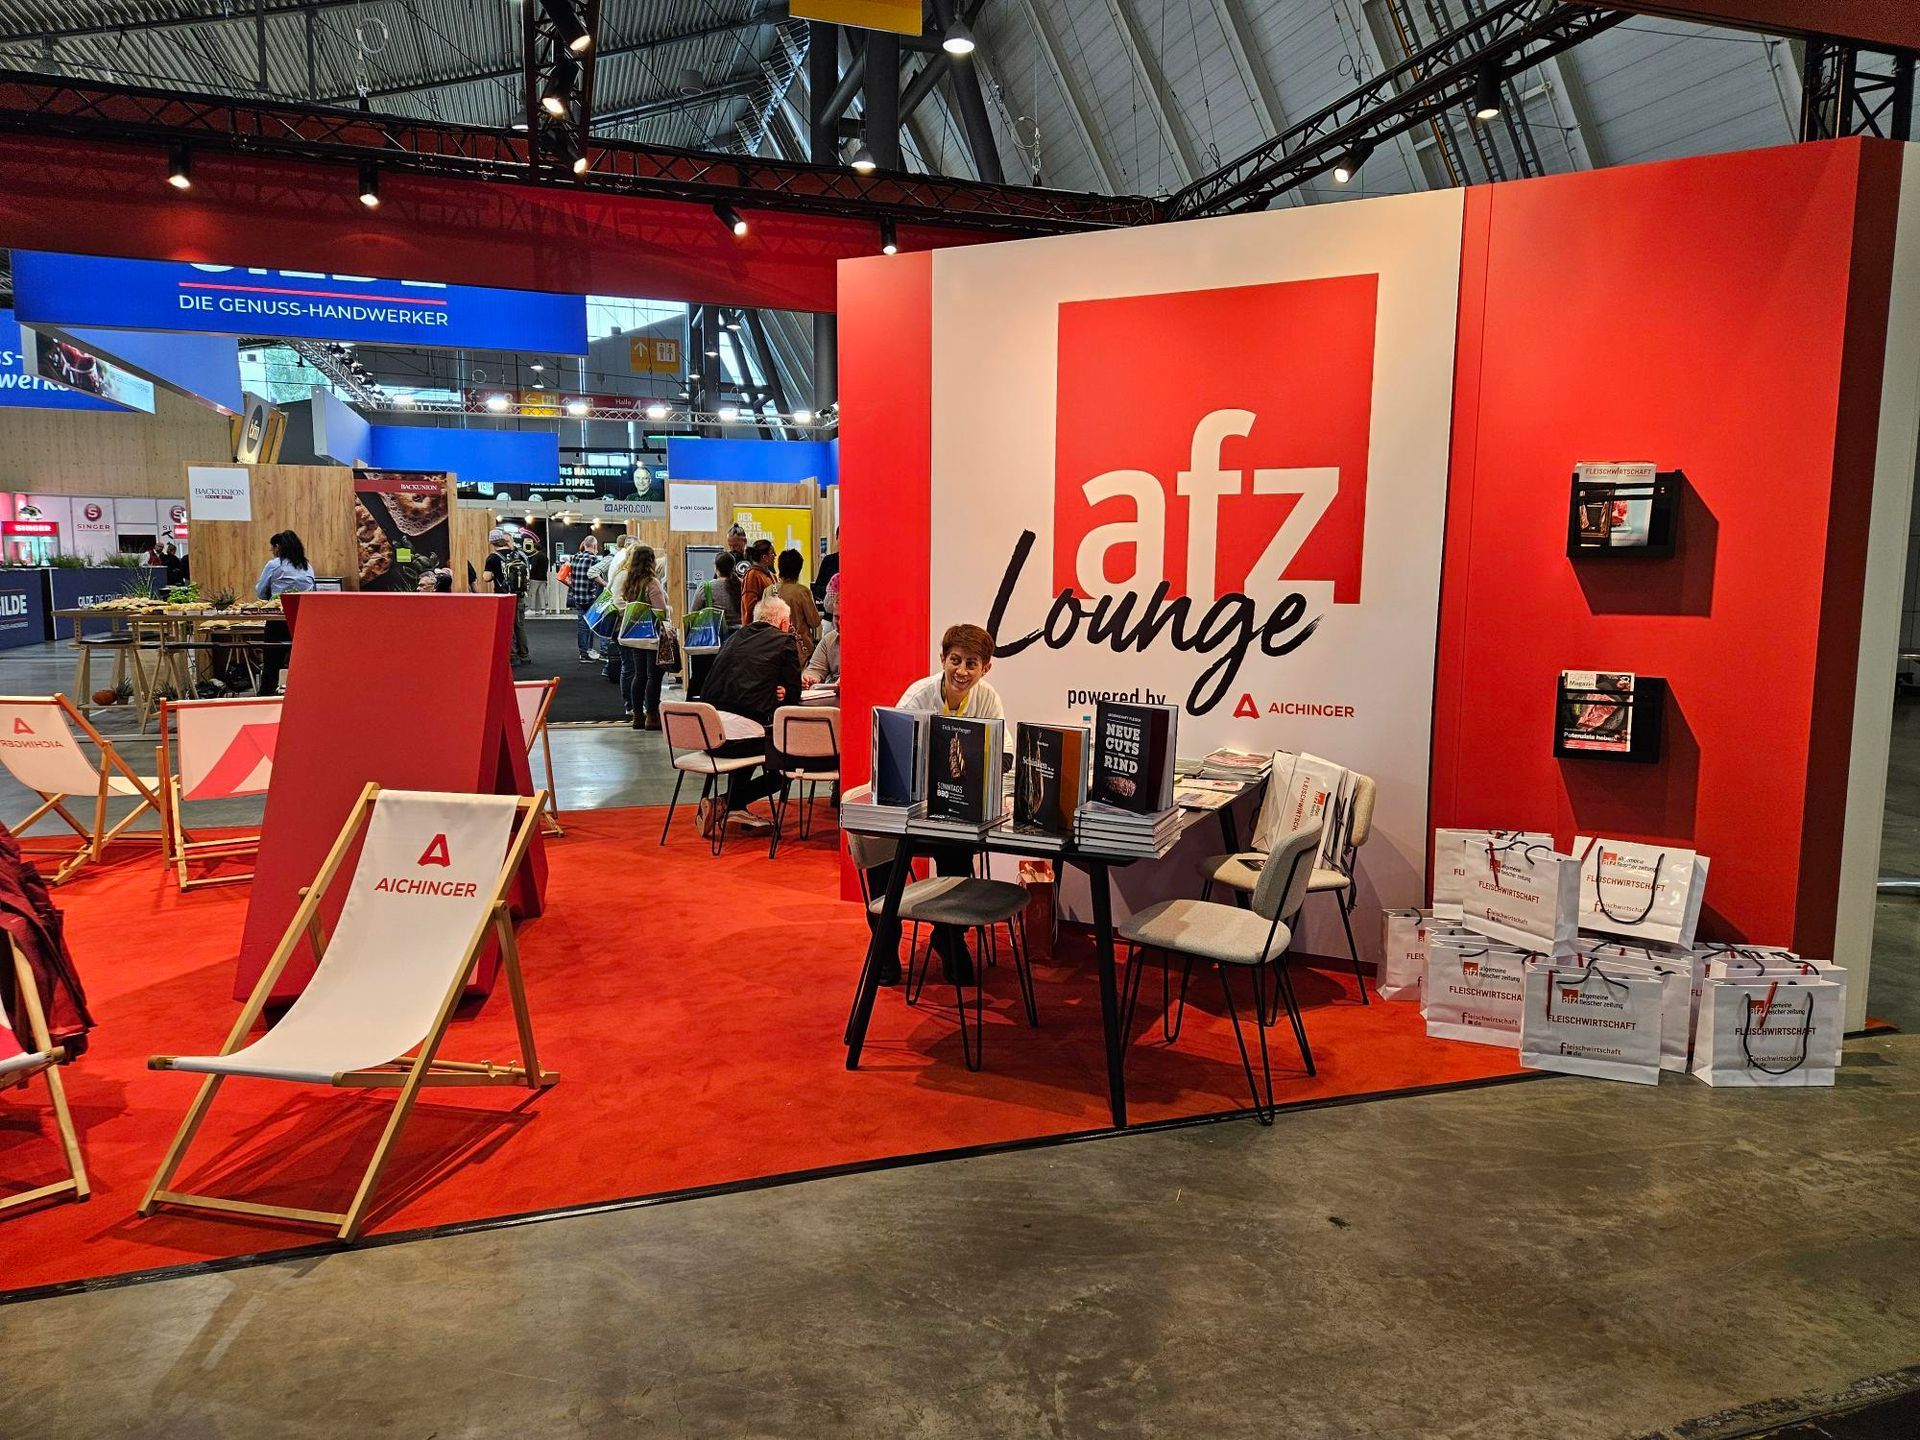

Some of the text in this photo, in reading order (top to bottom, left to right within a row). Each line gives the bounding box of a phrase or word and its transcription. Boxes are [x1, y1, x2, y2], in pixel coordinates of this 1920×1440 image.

[179, 295, 448, 326] DIE GENUSS-HANDWERKER
[573, 467, 622, 477] HANDWERK
[400, 483, 437, 491] BACKUNION
[565, 478, 595, 487] DIPPEL
[195, 487, 245, 496] BACKUNION
[1075, 408, 1340, 603] afz
[737, 512, 752, 521] DER
[0, 595, 28, 616] ILDE
[987, 529, 1325, 716] Lounge
[1268, 702, 1355, 718] AICHINGER
[1106, 723, 1141, 741] NEUE
[1105, 737, 1140, 755] CUTS
[1104, 754, 1138, 774] RIND
[936, 789, 949, 798] BBQ
[937, 782, 963, 793] SONNTAGS
[374, 878, 477, 897] AICHINGER
[1463, 965, 1507, 977] afz allgemeine
[1501, 975, 1521, 983] zeitung
[1579, 992, 1609, 1001] allgemeine
[1579, 998, 1624, 1010] fleischer zeitung
[1787, 1008, 1805, 1016] zeitung
[1547, 1014, 1636, 1031] FLEISCHWIRTSCHAFT
